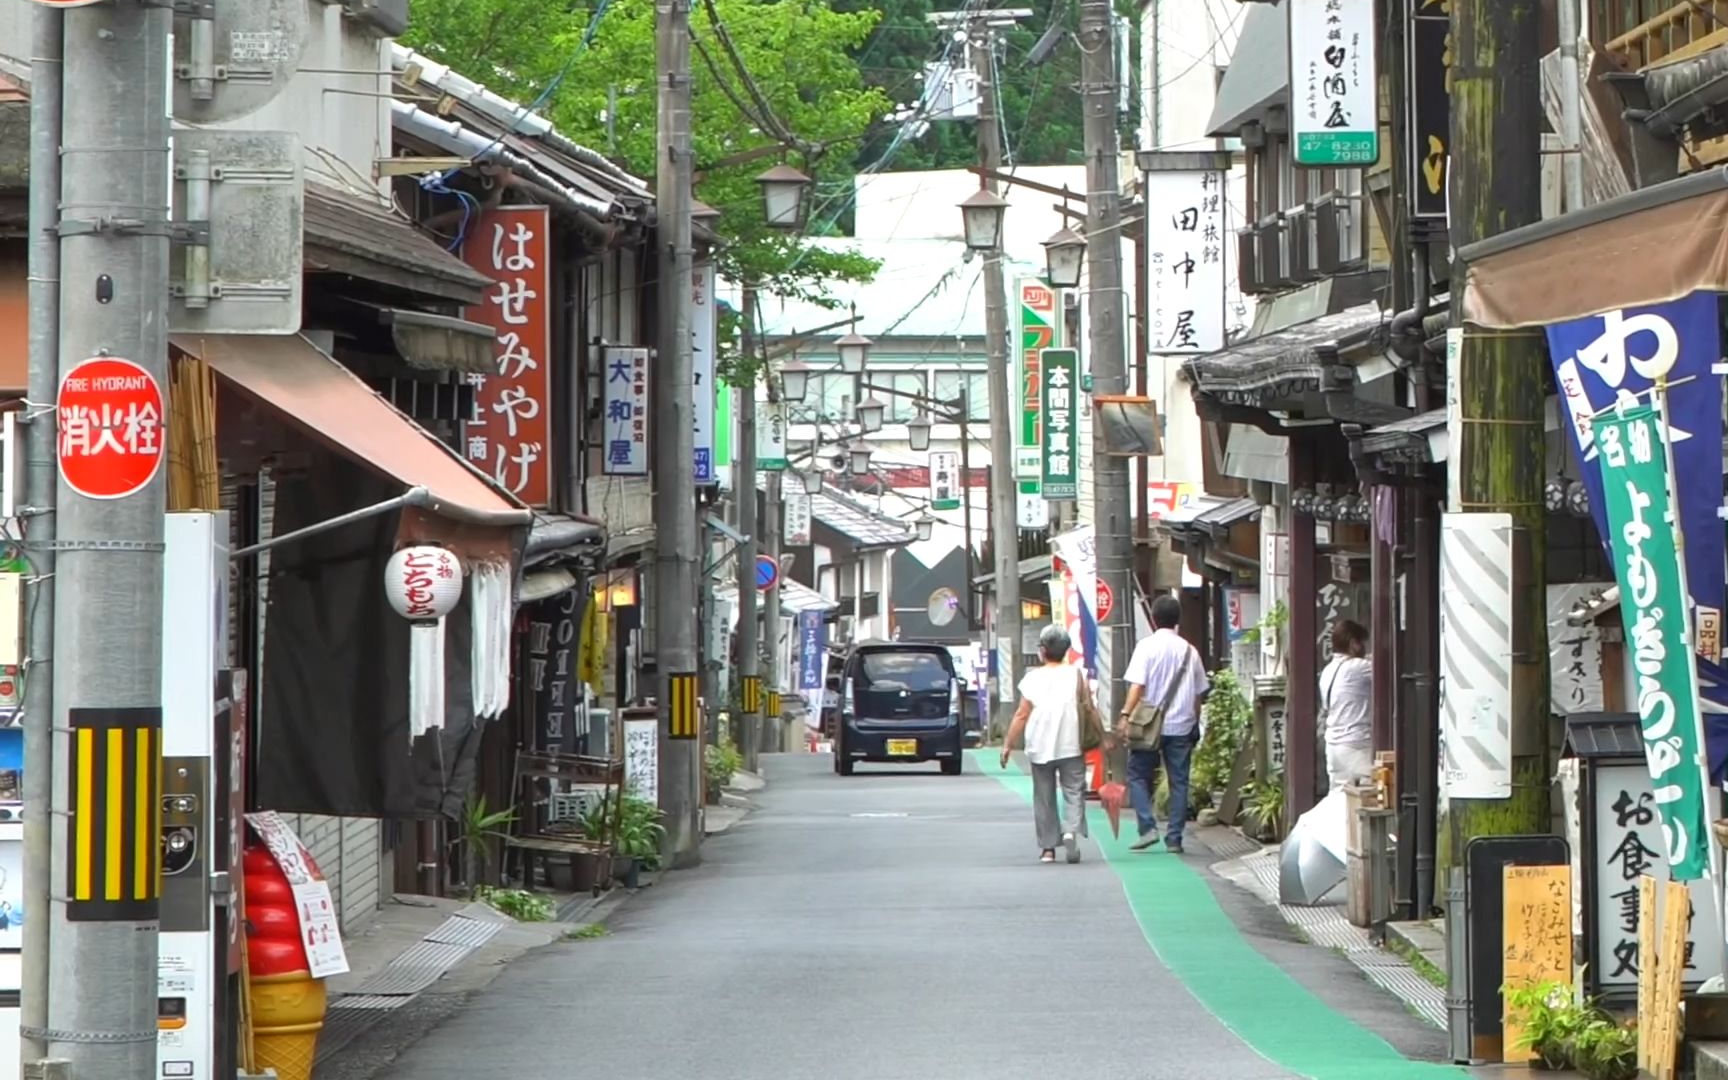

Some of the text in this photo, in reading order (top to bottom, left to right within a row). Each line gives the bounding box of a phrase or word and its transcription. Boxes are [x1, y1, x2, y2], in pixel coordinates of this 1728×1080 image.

[1201, 172, 1221, 264] 料理・旅館
[1166, 207, 1199, 348] 田中屋
[66, 375, 148, 392] FIRE HYDRANT
[490, 222, 541, 493] はせみやげ
[61, 401, 159, 457] 消火栓
[607, 359, 632, 466] 大和屋
[1048, 366, 1070, 476] 本間写真館
[1600, 420, 1652, 467] 名物
[403, 553, 436, 617] とちもち
